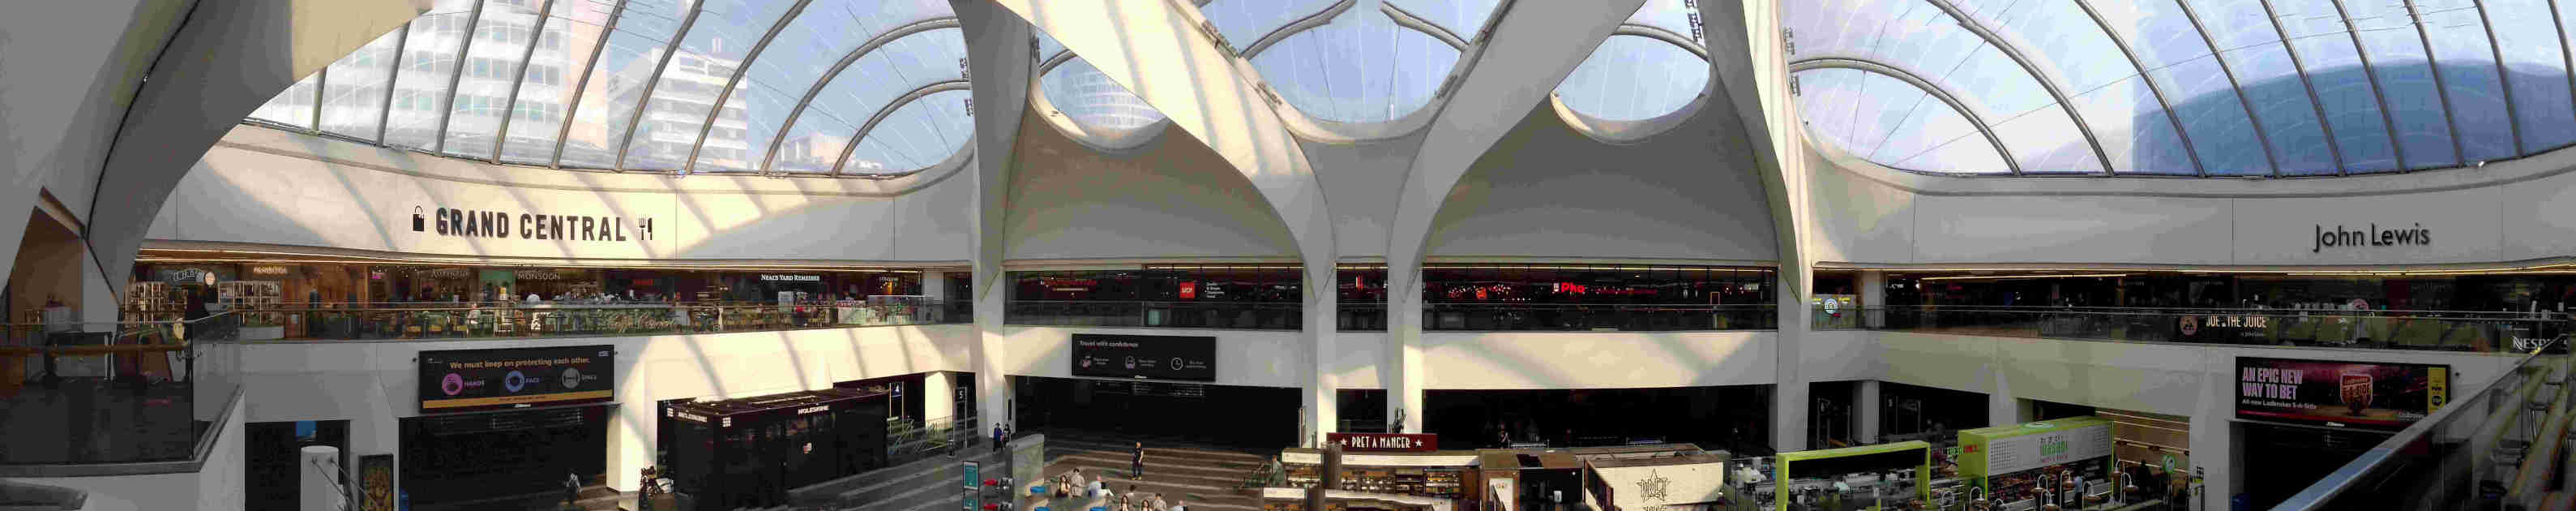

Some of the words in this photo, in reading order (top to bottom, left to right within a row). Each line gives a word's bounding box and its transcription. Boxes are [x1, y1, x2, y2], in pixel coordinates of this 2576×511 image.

[435, 207, 510, 238] GRAND
[520, 213, 627, 242] CENTRAL
[2313, 224, 2365, 252] John
[2371, 222, 2431, 247] Lewis
[518, 272, 560, 280] MONSOON
[1561, 281, 1585, 293] Pho
[2206, 315, 2219, 327] JOE
[2227, 315, 2242, 328] THE
[2243, 315, 2267, 328] JUICE
[485, 361, 503, 370] keep
[515, 358, 552, 369] protecting
[2243, 366, 2256, 382] AN
[2257, 367, 2279, 383] EPIC
[2280, 369, 2303, 384] NEW
[2242, 383, 2263, 397] WAY
[2264, 384, 2278, 398] TO
[2279, 384, 2297, 400] BET
[798, 406, 830, 415] MOLESKINE
[1351, 436, 1370, 449] PRET
[1371, 436, 1377, 449] A
[1380, 436, 1411, 449] MANGER
